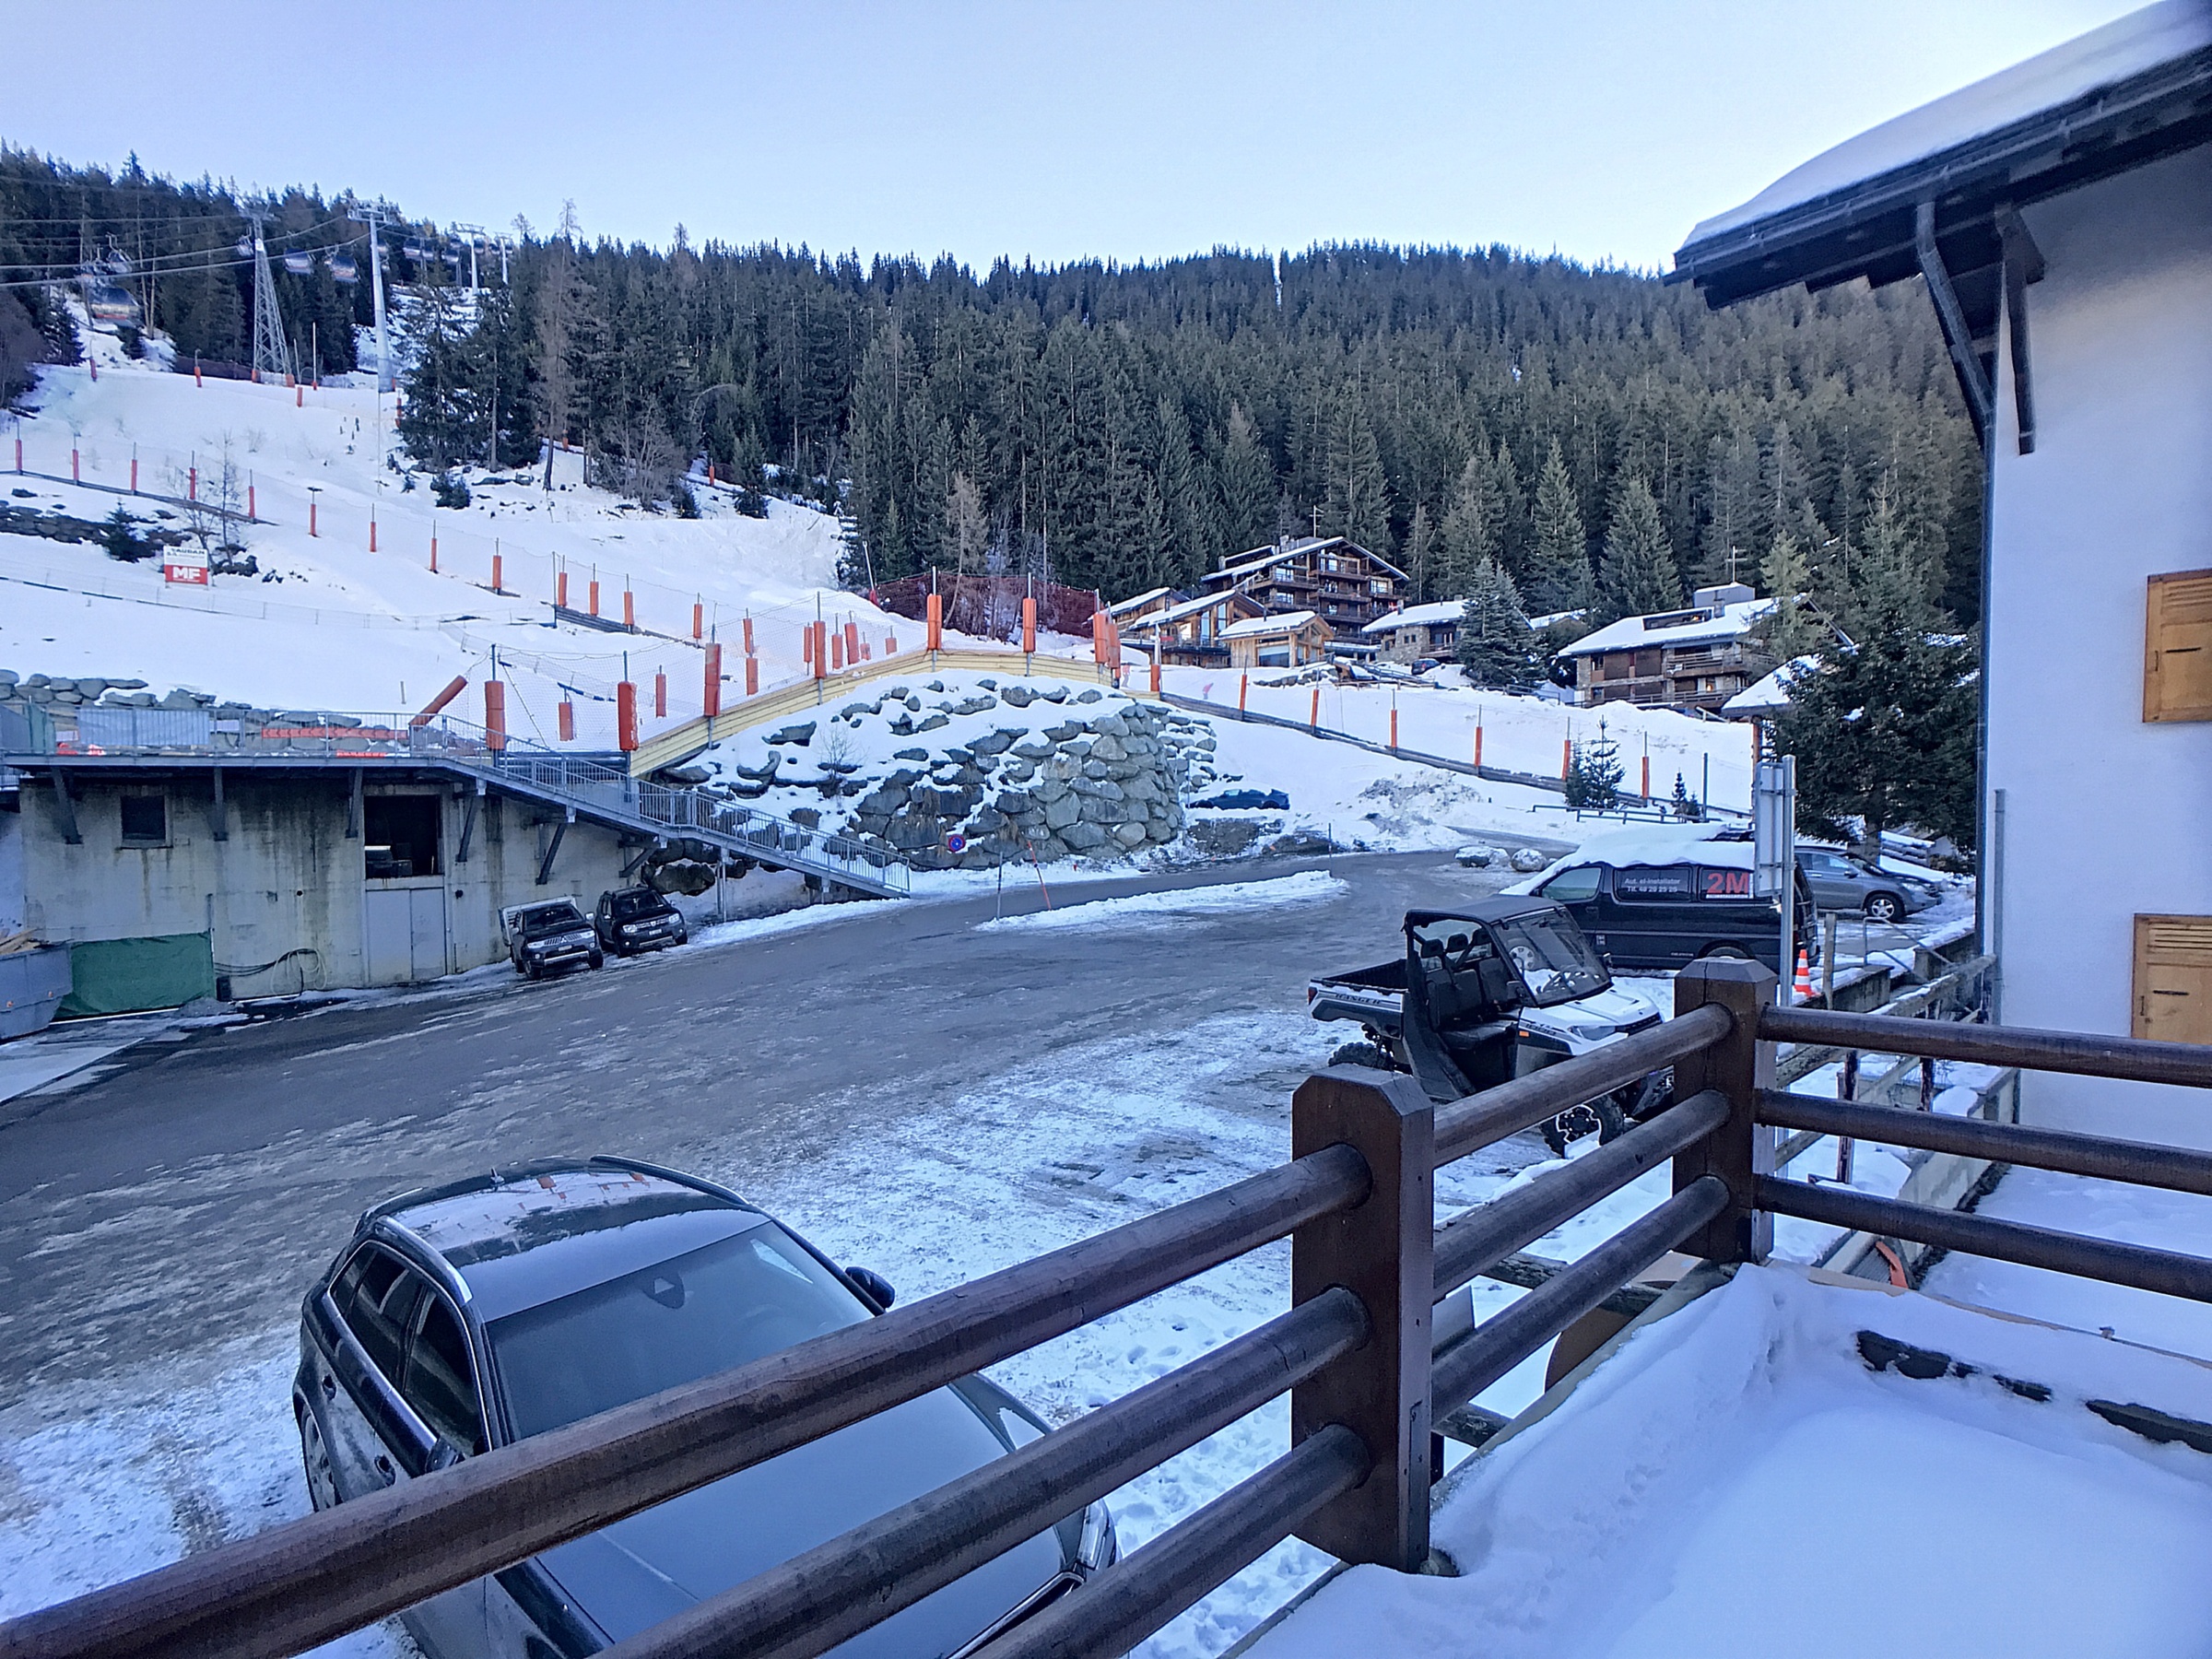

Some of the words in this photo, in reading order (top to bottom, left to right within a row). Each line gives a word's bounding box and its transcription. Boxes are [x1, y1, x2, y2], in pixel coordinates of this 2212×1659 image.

[172, 566, 201, 580] MF
[1707, 872, 1748, 893] 2M
[1335, 994, 1382, 1005] RANGER
